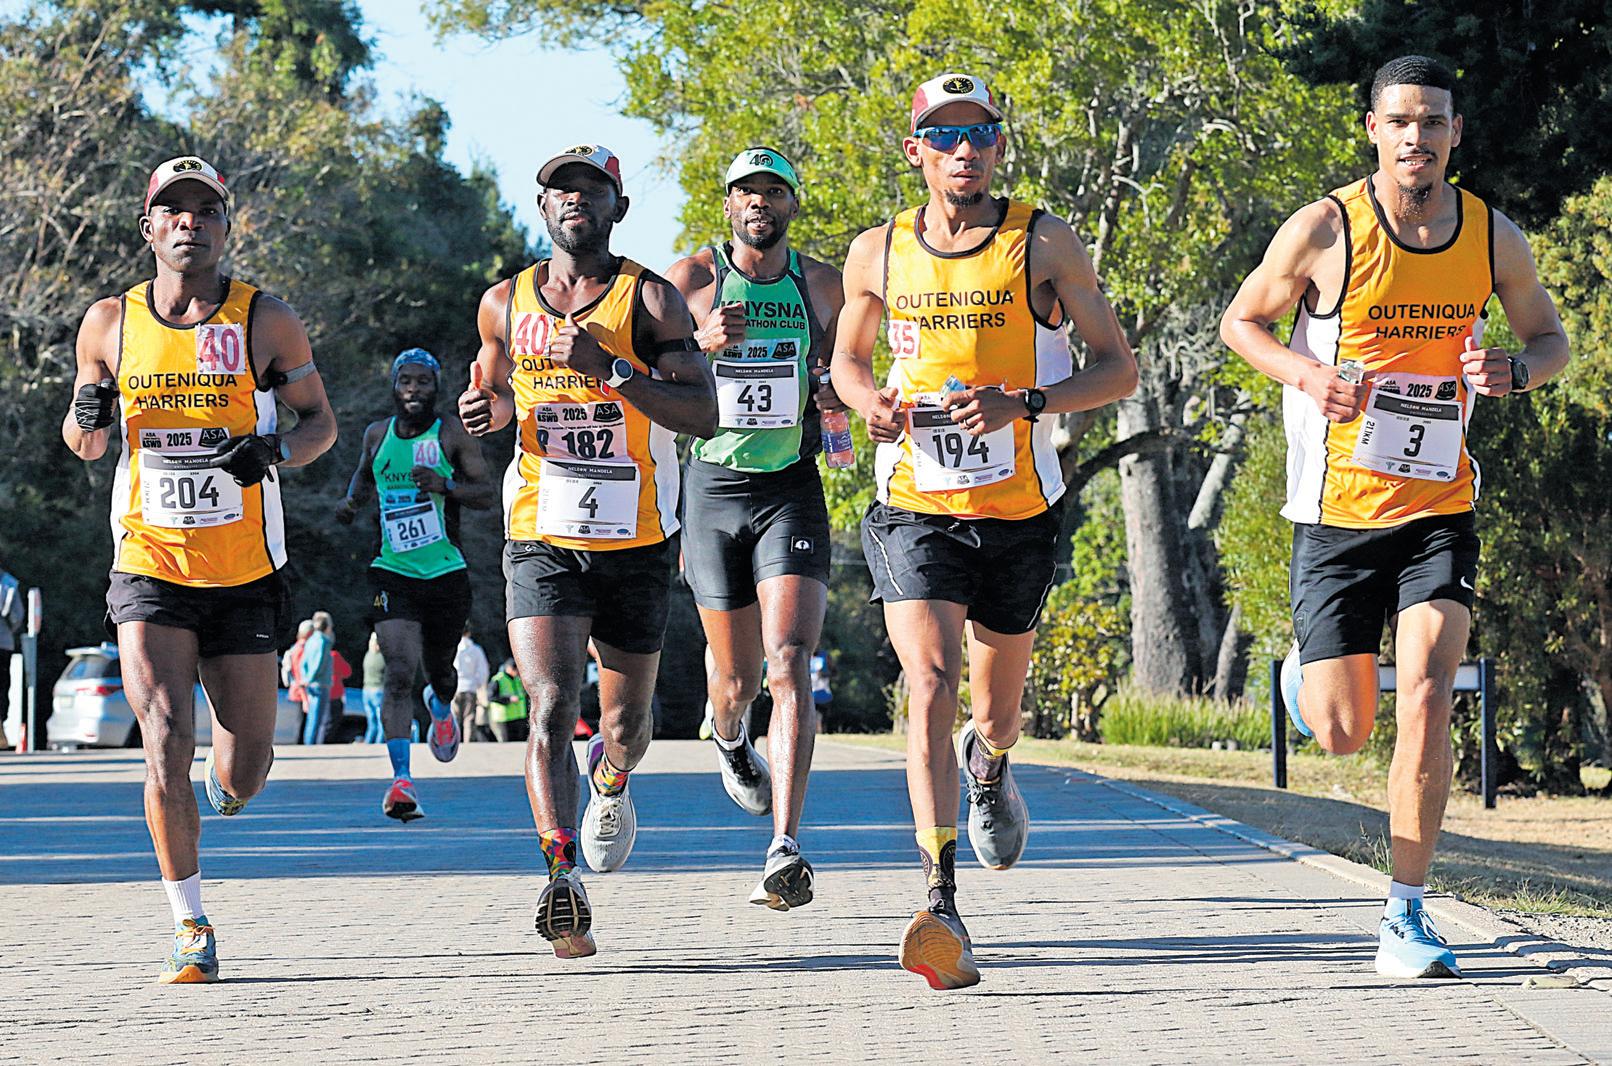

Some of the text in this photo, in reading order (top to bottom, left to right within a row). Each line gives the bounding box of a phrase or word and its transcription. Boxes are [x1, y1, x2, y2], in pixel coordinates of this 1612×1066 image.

[896, 290, 1014, 310] OUTENIQUA
[1368, 303, 1475, 320] OUTENIQUA
[515, 313, 549, 355] 40
[745, 319, 806, 330] ATHON CLUB
[1376, 324, 1466, 339] HARRIERS
[199, 327, 240, 372] 40
[747, 346, 768, 358] 2025
[776, 343, 795, 353] ASA
[128, 372, 238, 390] OUTENIQUA
[533, 375, 605, 390] HARRIE
[1406, 383, 1433, 398] 2025
[1439, 383, 1456, 392] ASA
[136, 393, 230, 410] HARRIERS
[736, 384, 772, 413] 43
[562, 404, 619, 422] 2025 ASA
[166, 429, 226, 447] 2025 ASA
[561, 428, 615, 459] 182
[1403, 424, 1425, 457] 3
[415, 441, 438, 466] 40
[932, 432, 990, 468] 194
[385, 471, 414, 482] KNYS
[159, 475, 220, 509] 204
[578, 486, 599, 519] 4
[397, 517, 427, 541] 261
